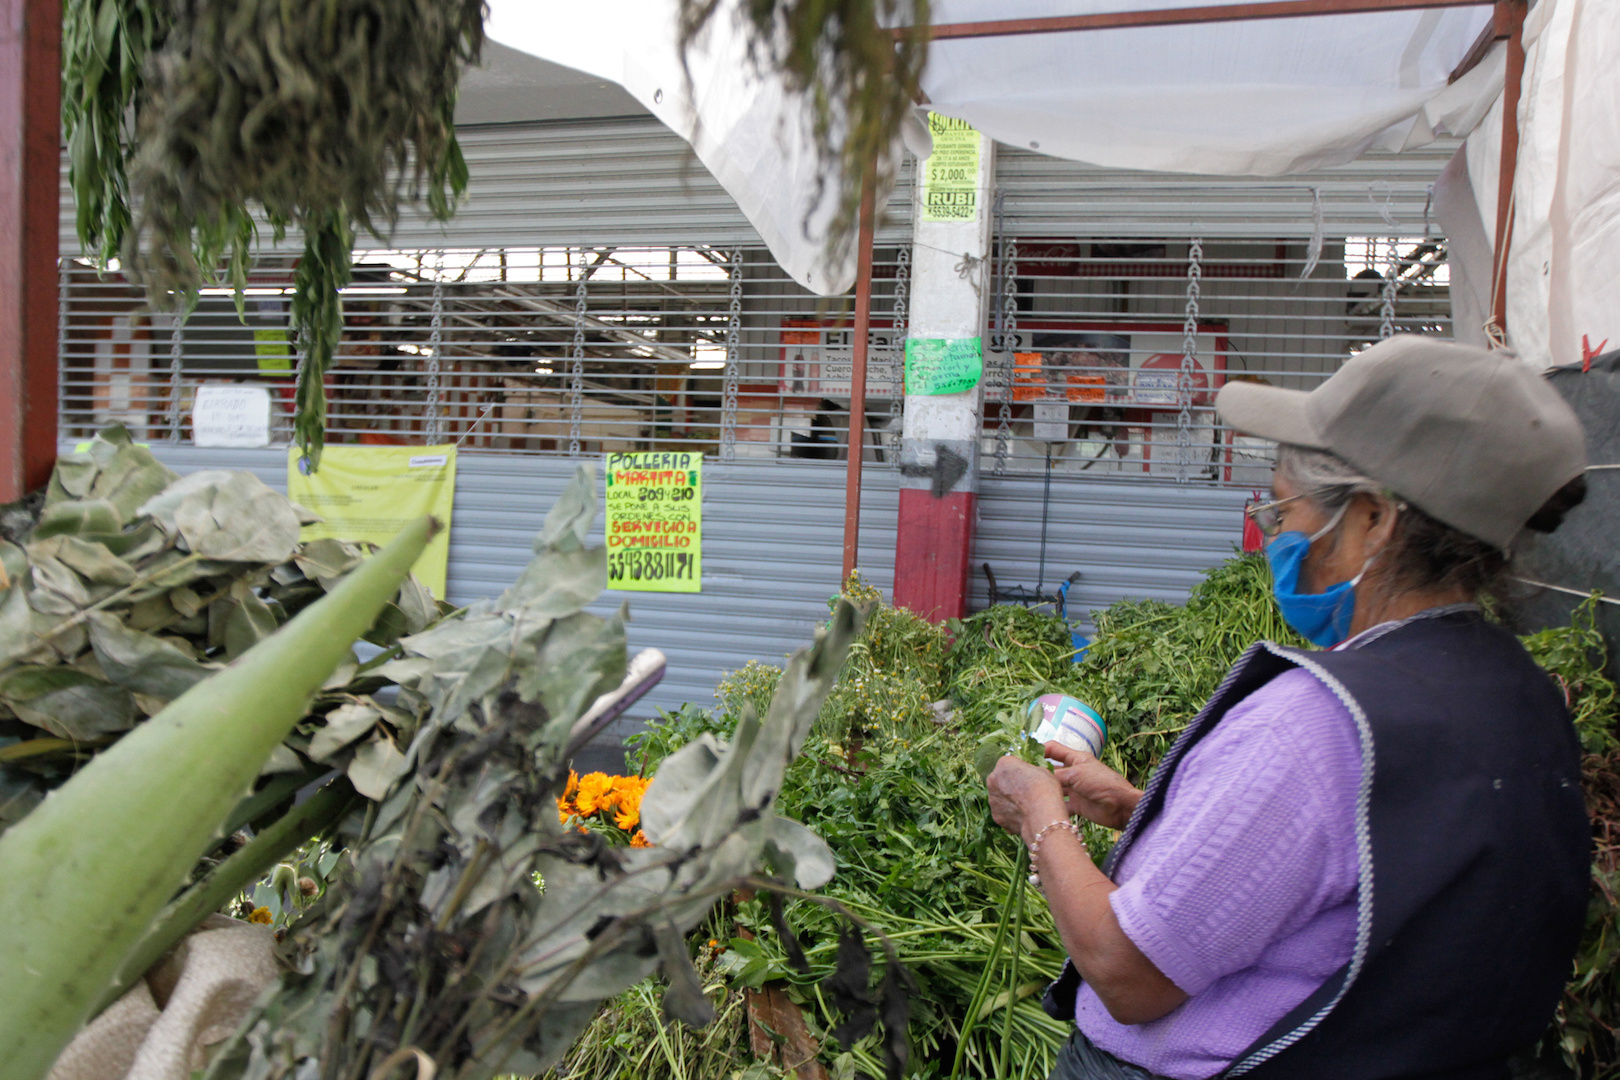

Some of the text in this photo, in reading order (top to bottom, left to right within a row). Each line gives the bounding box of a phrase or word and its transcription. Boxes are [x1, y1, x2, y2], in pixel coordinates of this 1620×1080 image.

[929, 192, 974, 205] RUBI
[609, 453, 691, 471] POLLERIA
[615, 470, 686, 487] MARTITA
[607, 490, 635, 500] LOCAL
[637, 487, 664, 501] 209
[671, 487, 694, 501] 210
[608, 503, 623, 511] SE
[625, 503, 648, 511] PONE
[664, 504, 691, 513] SUS
[611, 512, 691, 522] ORDENES CON
[611, 520, 697, 534] SERVICIO A
[608, 535, 691, 548] DOMICILIO
